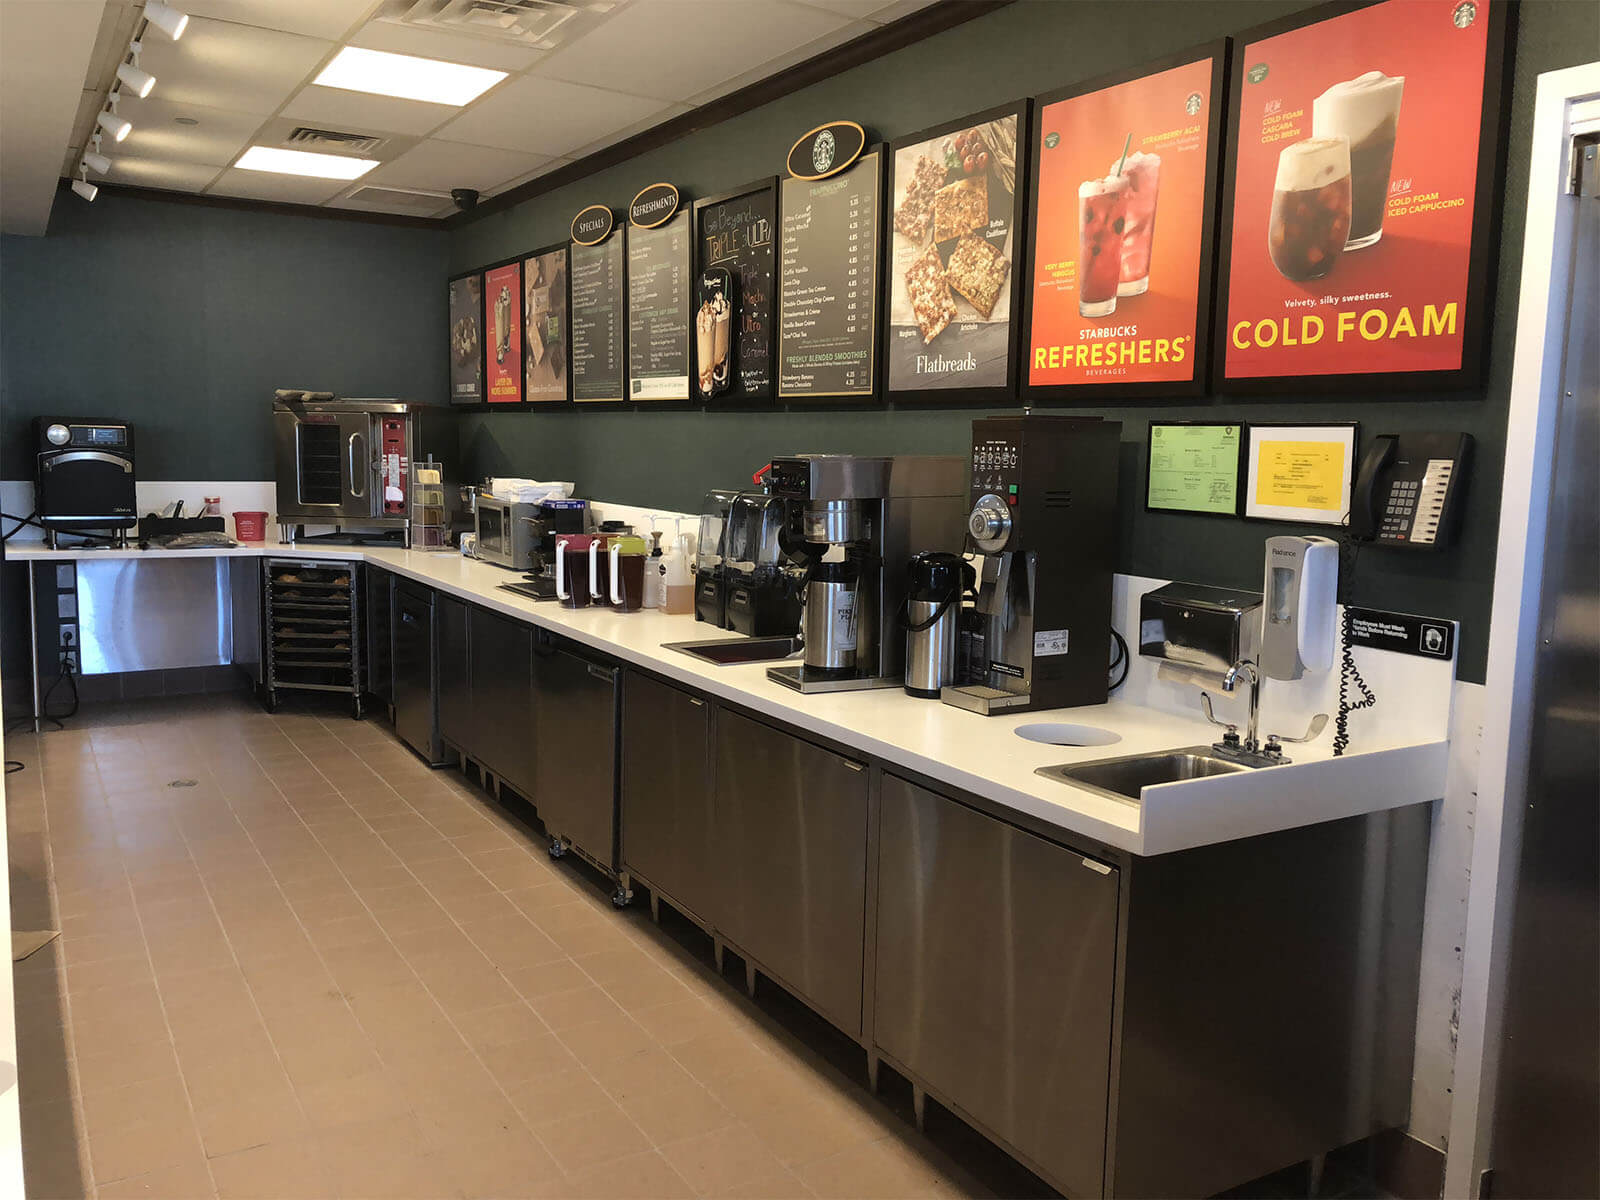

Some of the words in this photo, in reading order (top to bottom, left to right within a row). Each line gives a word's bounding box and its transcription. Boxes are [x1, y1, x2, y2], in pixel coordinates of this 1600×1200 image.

[1263, 115, 1281, 126] COLD
[1283, 109, 1304, 120] FOAM
[1262, 121, 1293, 135] CASCARA
[1261, 133, 1280, 144] COLD
[632, 195, 676, 217] REFRESHMENTS
[1388, 196, 1411, 208] COLD
[1413, 192, 1440, 204] FOAM
[1388, 205, 1407, 218] ICED
[1408, 198, 1465, 215] CAPPUCCINO
[579, 218, 604, 233] SPECIALS
[1285, 298, 1318, 310] Velvety,
[1319, 294, 1341, 307] silky
[1341, 290, 1393, 303] sweetness.
[1079, 325, 1137, 340] STARBUCKS
[1231, 314, 1325, 351] COLD
[1336, 302, 1458, 343] FOAM
[786, 355, 808, 364] FRESHLY
[809, 352, 834, 362] BLENDED
[834, 350, 868, 360] SMOOTHIES
[1034, 337, 1186, 369] REFRESHERS
[915, 351, 977, 375] Flatbreads
[1086, 367, 1127, 376] BEVERAGES
[1272, 547, 1297, 558] Radiance
[1378, 622, 1391, 630] Must
